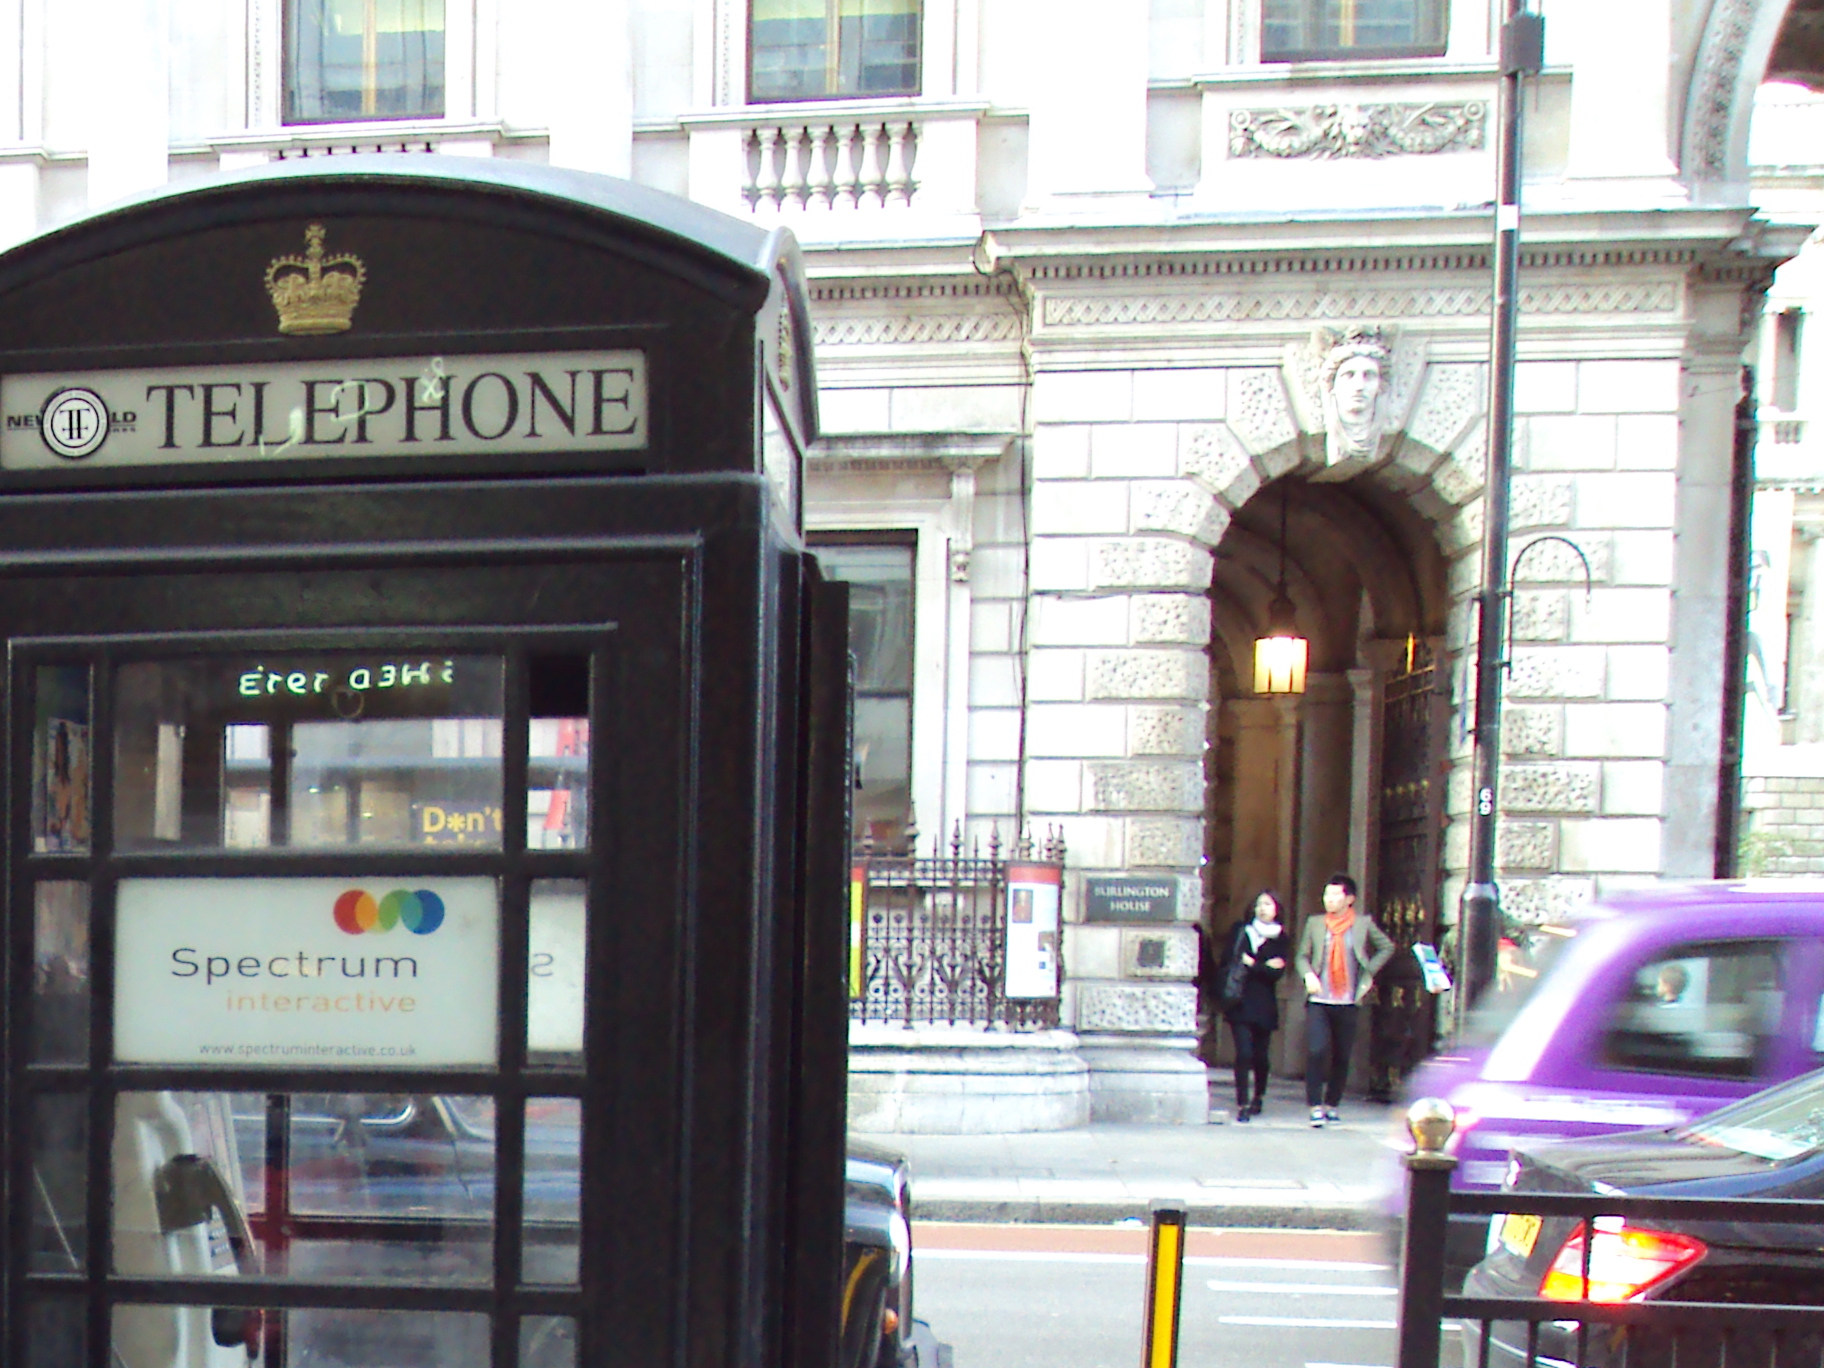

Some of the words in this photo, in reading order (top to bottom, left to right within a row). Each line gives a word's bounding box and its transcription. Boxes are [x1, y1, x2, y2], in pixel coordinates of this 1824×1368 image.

[146, 367, 639, 450] TELEPHONE
[1093, 885, 1170, 898] BURLINGTON
[1110, 900, 1152, 912] HOUSE
[170, 945, 420, 985] Spectrum
[225, 990, 418, 1014] interactive
[198, 1042, 418, 1057] www.spectruminteractive.co.uk
